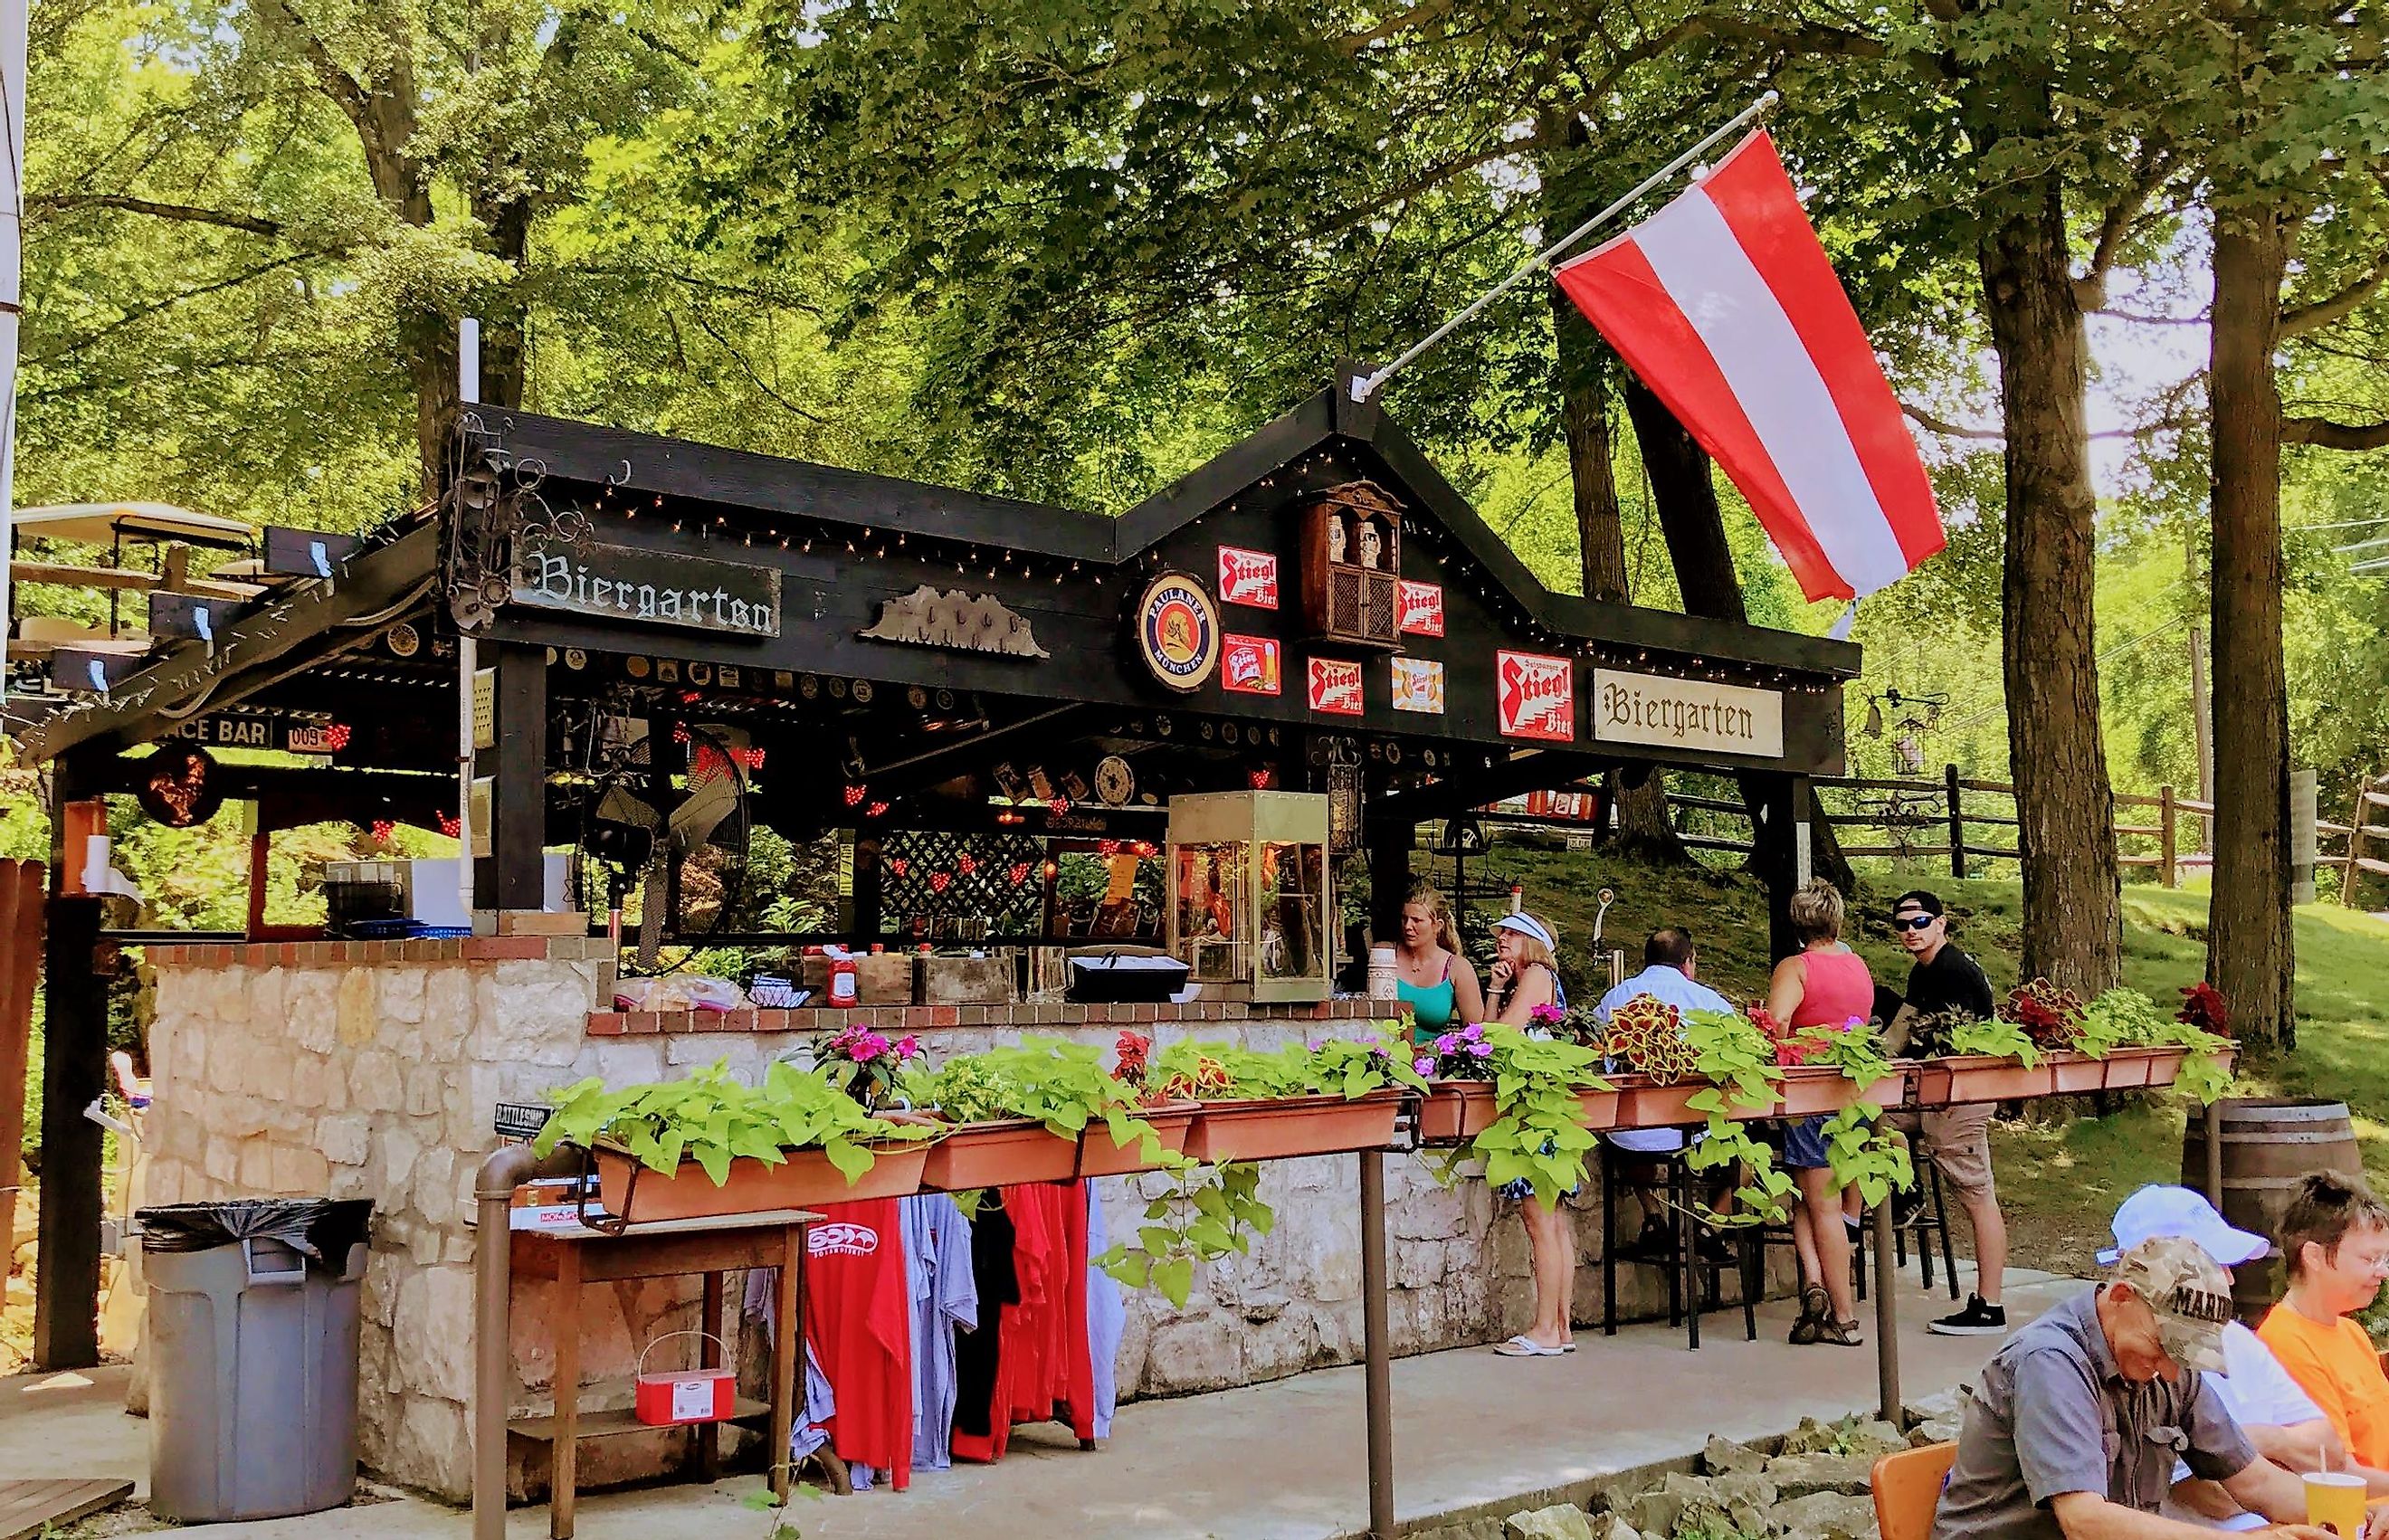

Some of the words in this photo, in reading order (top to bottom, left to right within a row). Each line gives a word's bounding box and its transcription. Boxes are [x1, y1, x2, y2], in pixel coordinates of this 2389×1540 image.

[527, 550, 771, 634] Biergarten
[1223, 552, 1274, 599] Stiegl
[1149, 588, 1206, 624] PAULANER
[1255, 589, 1276, 606] Bier
[1311, 661, 1359, 707] Stiegl
[1502, 657, 1568, 730] Stiegl
[1341, 697, 1362, 711] Bier
[1604, 682, 1754, 740] Biergarten
[218, 721, 266, 744] BAR
[1544, 712, 1572, 735] Bier
[495, 1104, 545, 1128] BATTLESHIP
